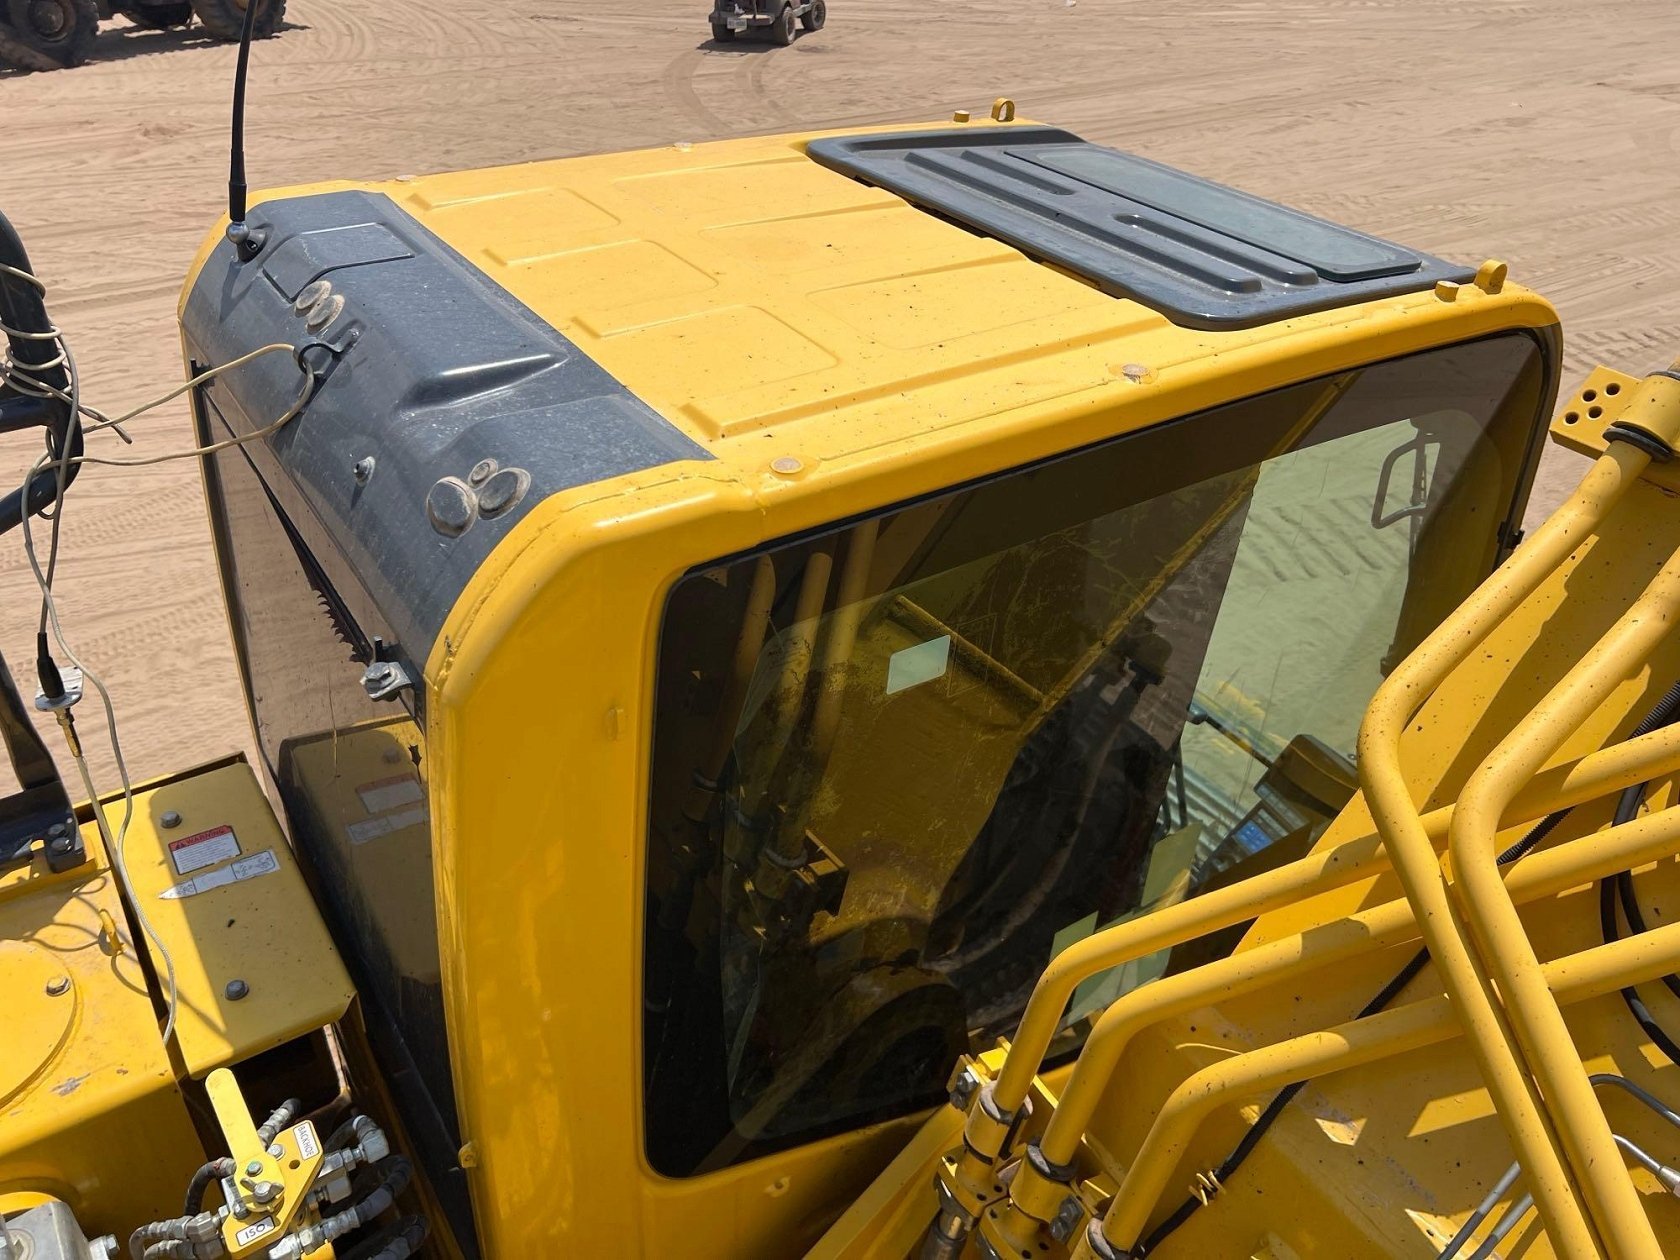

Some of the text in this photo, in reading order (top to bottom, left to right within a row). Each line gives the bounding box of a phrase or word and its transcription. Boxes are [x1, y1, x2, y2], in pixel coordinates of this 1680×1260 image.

[187, 829, 226, 844] WARNING
[298, 1126, 315, 1156] BACKHOE
[245, 1223, 266, 1239] ISO
